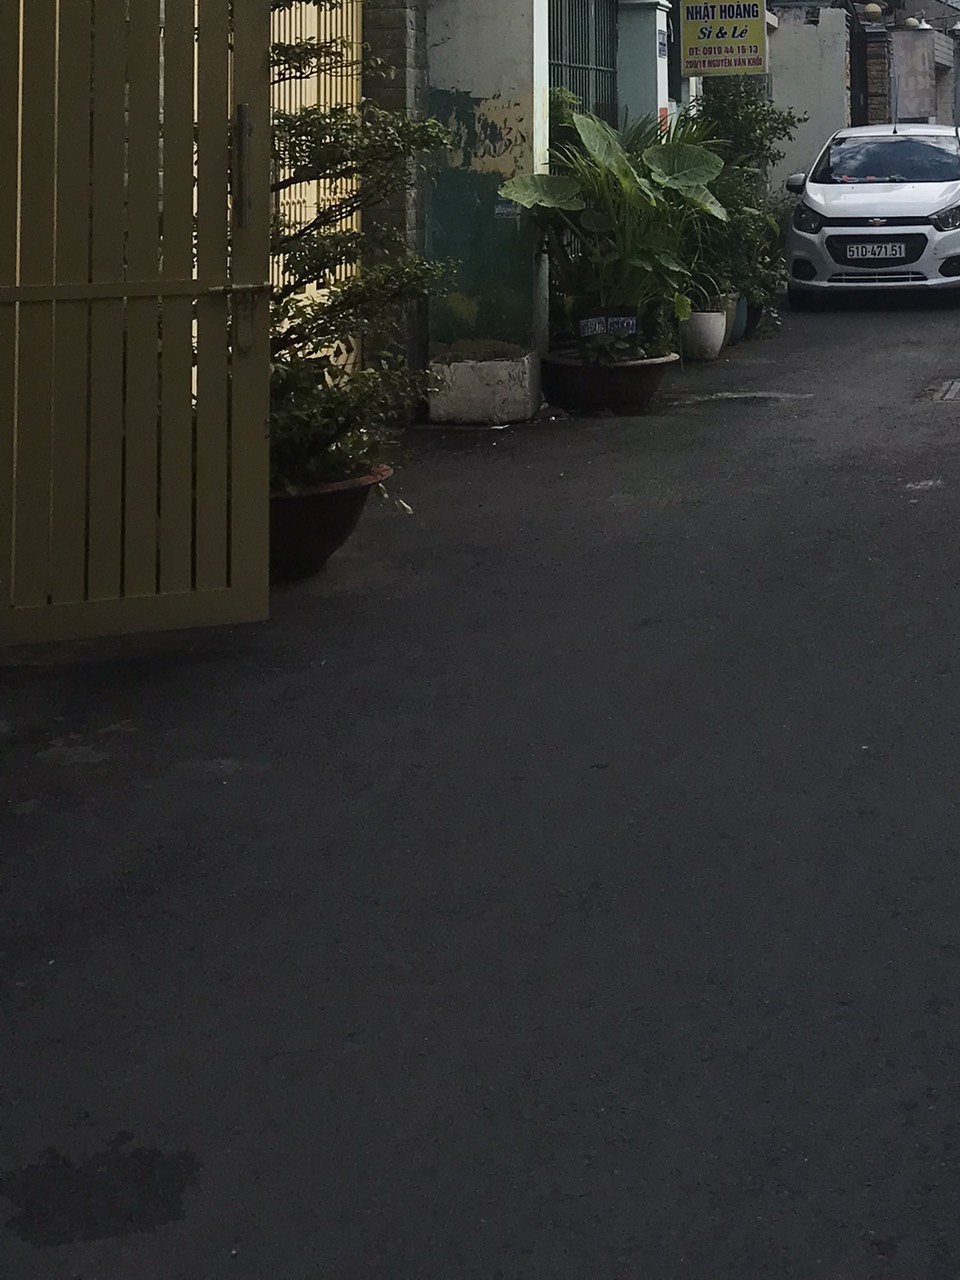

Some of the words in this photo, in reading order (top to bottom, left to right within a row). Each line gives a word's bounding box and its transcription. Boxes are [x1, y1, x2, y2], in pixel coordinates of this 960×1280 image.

[686, 2, 716, 23] NHẬT
[720, 1, 759, 19] HOÀNG
[715, 26, 728, 39] &
[724, 46, 734, 54] 44
[748, 45, 758, 54] 13
